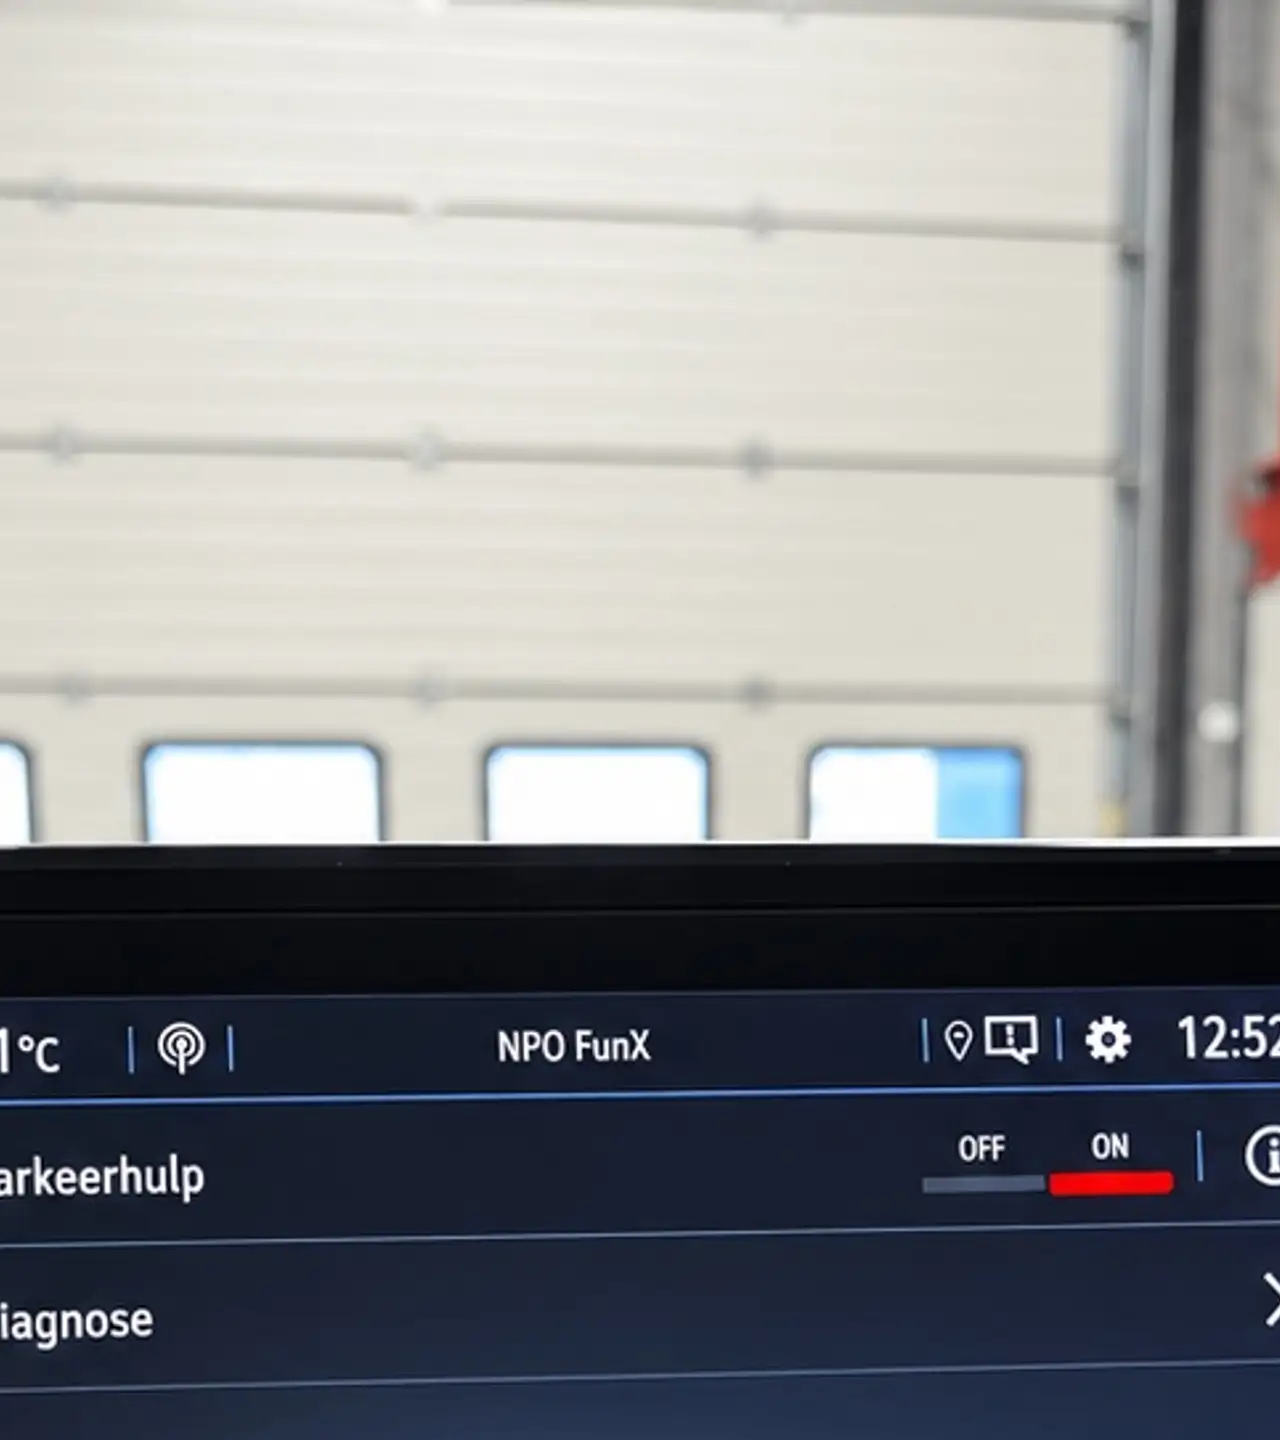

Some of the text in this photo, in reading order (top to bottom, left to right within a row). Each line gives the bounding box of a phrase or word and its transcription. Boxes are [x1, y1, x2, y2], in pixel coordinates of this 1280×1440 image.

[498, 1028, 652, 1062] NPO FunX
[957, 1134, 1006, 1162] OFF
[1091, 1132, 1130, 1161] ON
